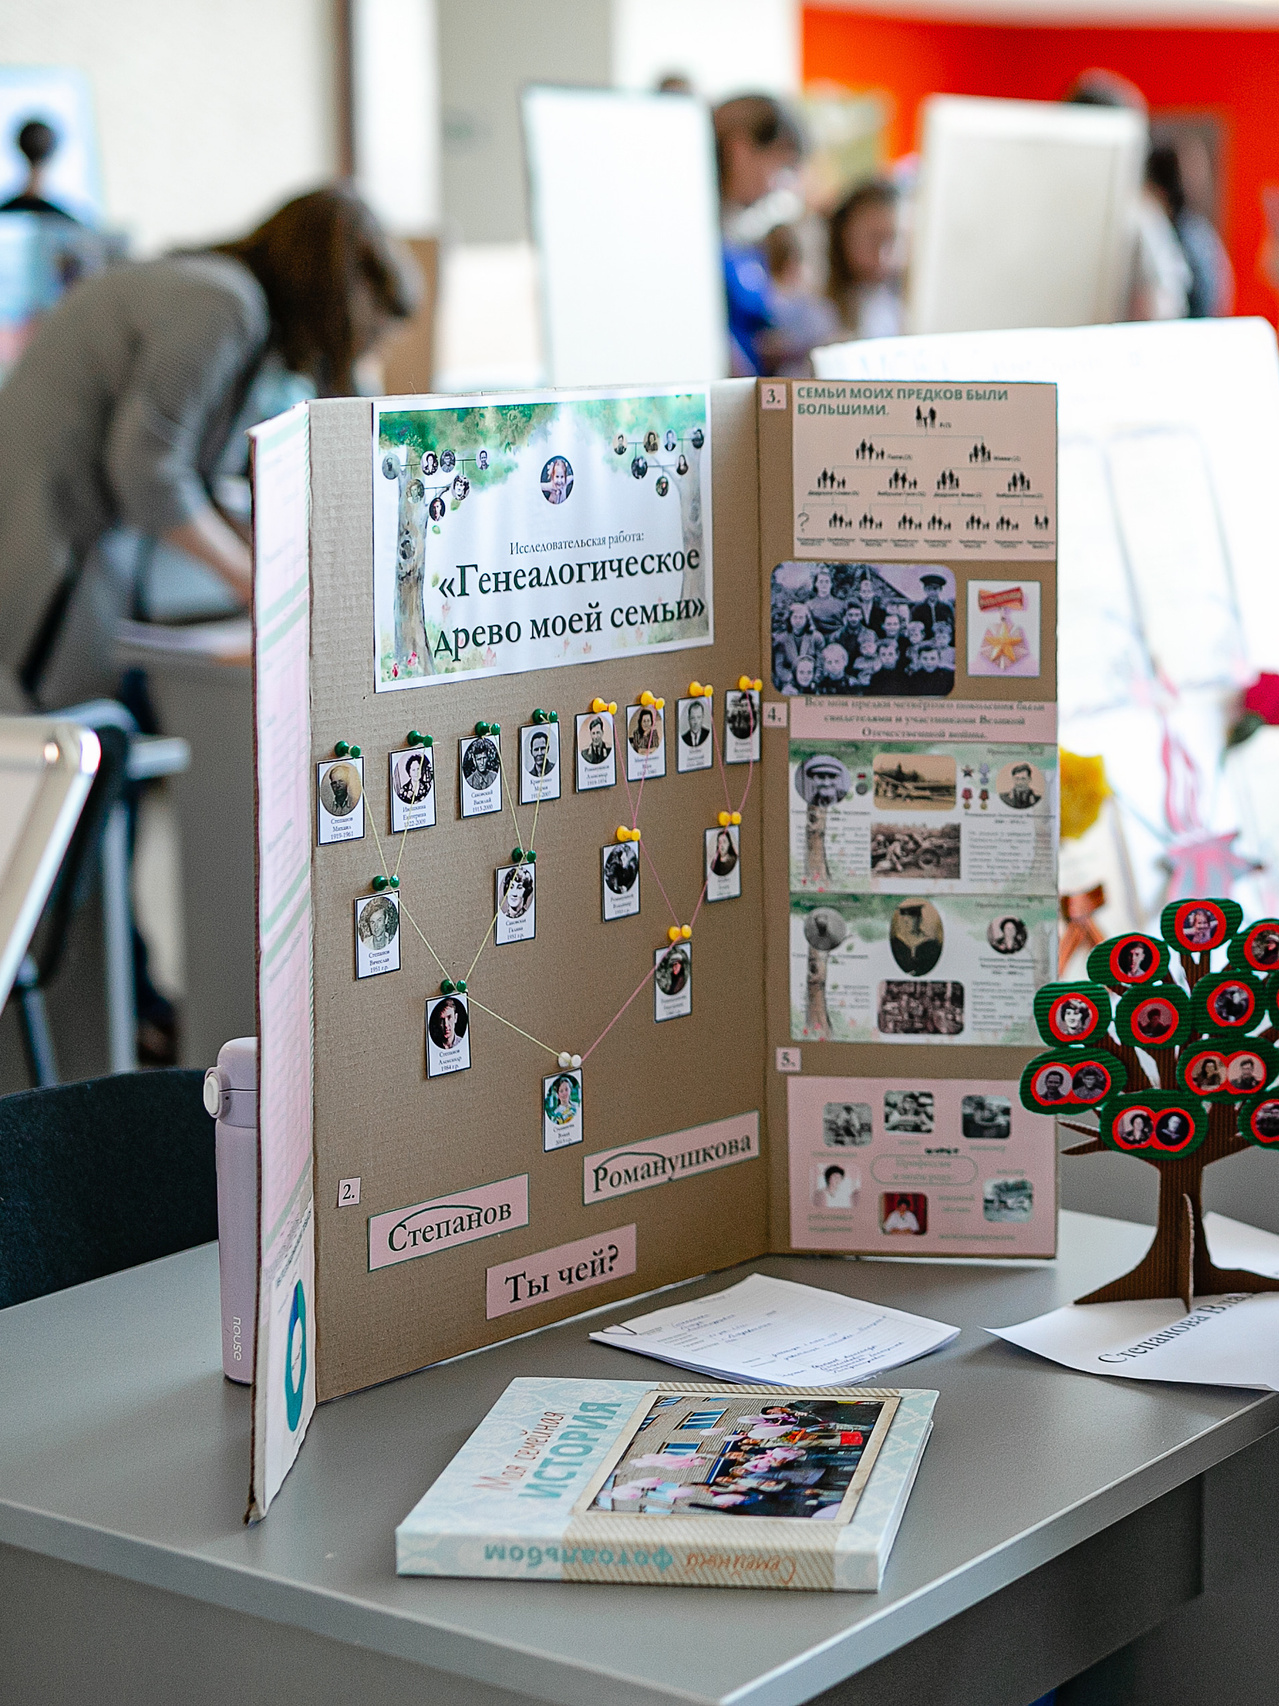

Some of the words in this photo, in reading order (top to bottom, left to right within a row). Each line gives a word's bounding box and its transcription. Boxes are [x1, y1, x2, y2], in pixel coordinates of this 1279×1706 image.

[766, 389, 781, 404] 3.
[796, 403, 889, 416] БОЛЬШИМИ.
[797, 387, 847, 399] СЕМЬИ
[849, 387, 894, 399] МОИХ
[897, 388, 962, 402] ПРЕДКОВ
[965, 389, 1009, 401] БЫЛИ
[509, 534, 607, 556] Исследовательская
[608, 530, 645, 550] работа:
[438, 548, 700, 598] «Генеалогическое
[434, 620, 522, 662] древо
[530, 602, 603, 640] моей
[610, 597, 706, 629] семьи»
[766, 707, 783, 723] 4.
[592, 1134, 752, 1193] Романушкова
[341, 1183, 356, 1201] 2.
[387, 1202, 512, 1254] Степанов
[504, 1271, 549, 1304] Ты
[558, 1244, 619, 1285] чей?
[233, 1316, 242, 1361] nouse
[1097, 1313, 1211, 1364] Степанова
[1196, 1293, 1255, 1315] Вла
[517, 1401, 623, 1499] ИСТОРИЯ
[472, 1464, 528, 1492] Моя
[484, 1543, 674, 1573] фотоальбом
